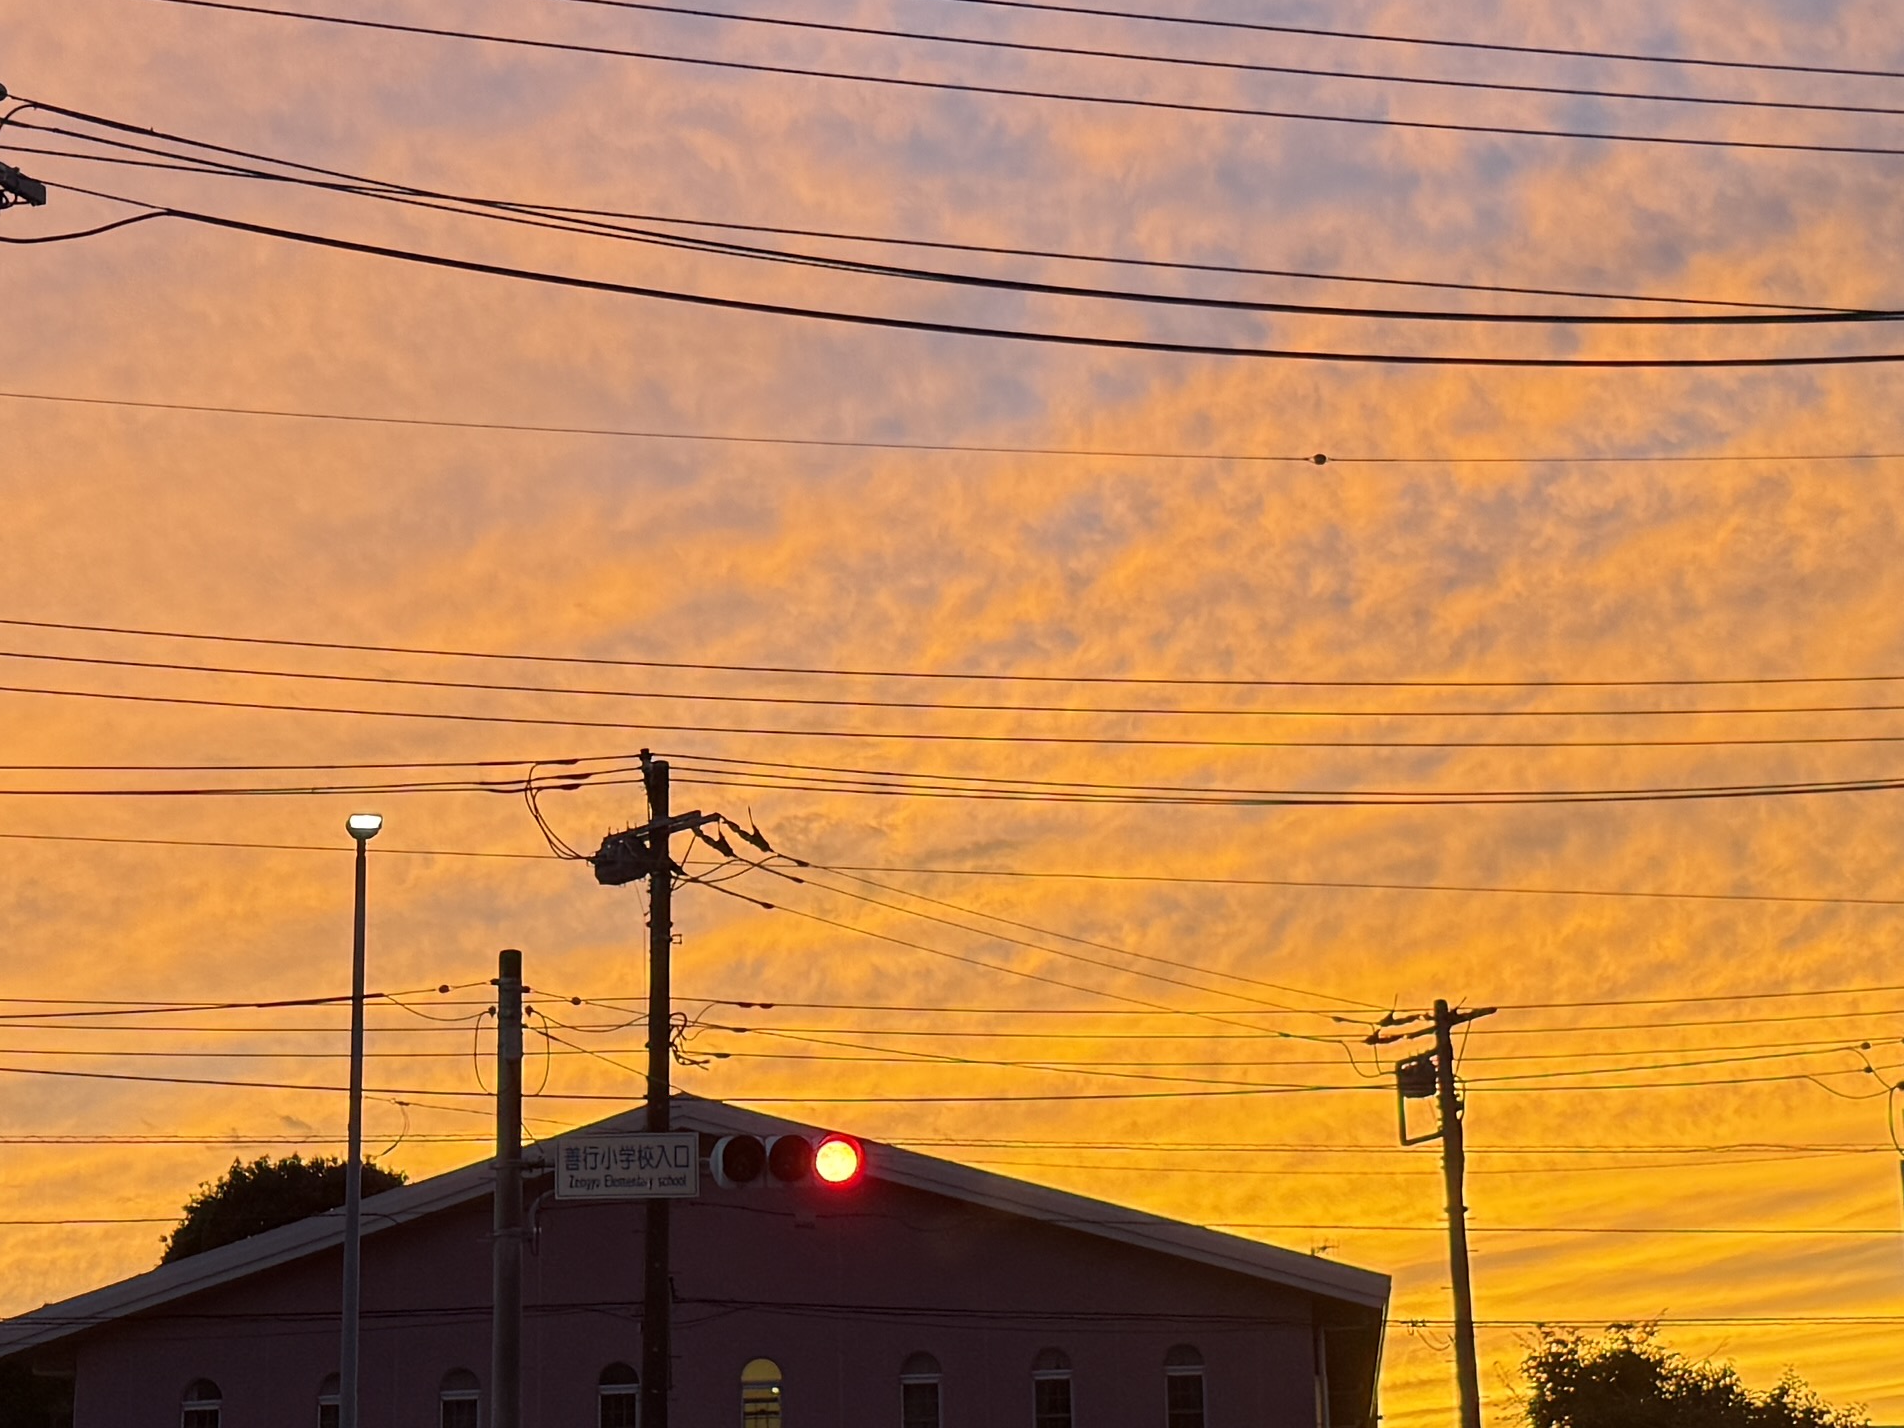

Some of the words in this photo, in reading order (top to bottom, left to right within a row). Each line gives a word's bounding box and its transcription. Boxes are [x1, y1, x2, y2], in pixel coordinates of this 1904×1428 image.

[564, 1144, 690, 1171] 善行小学校入口
